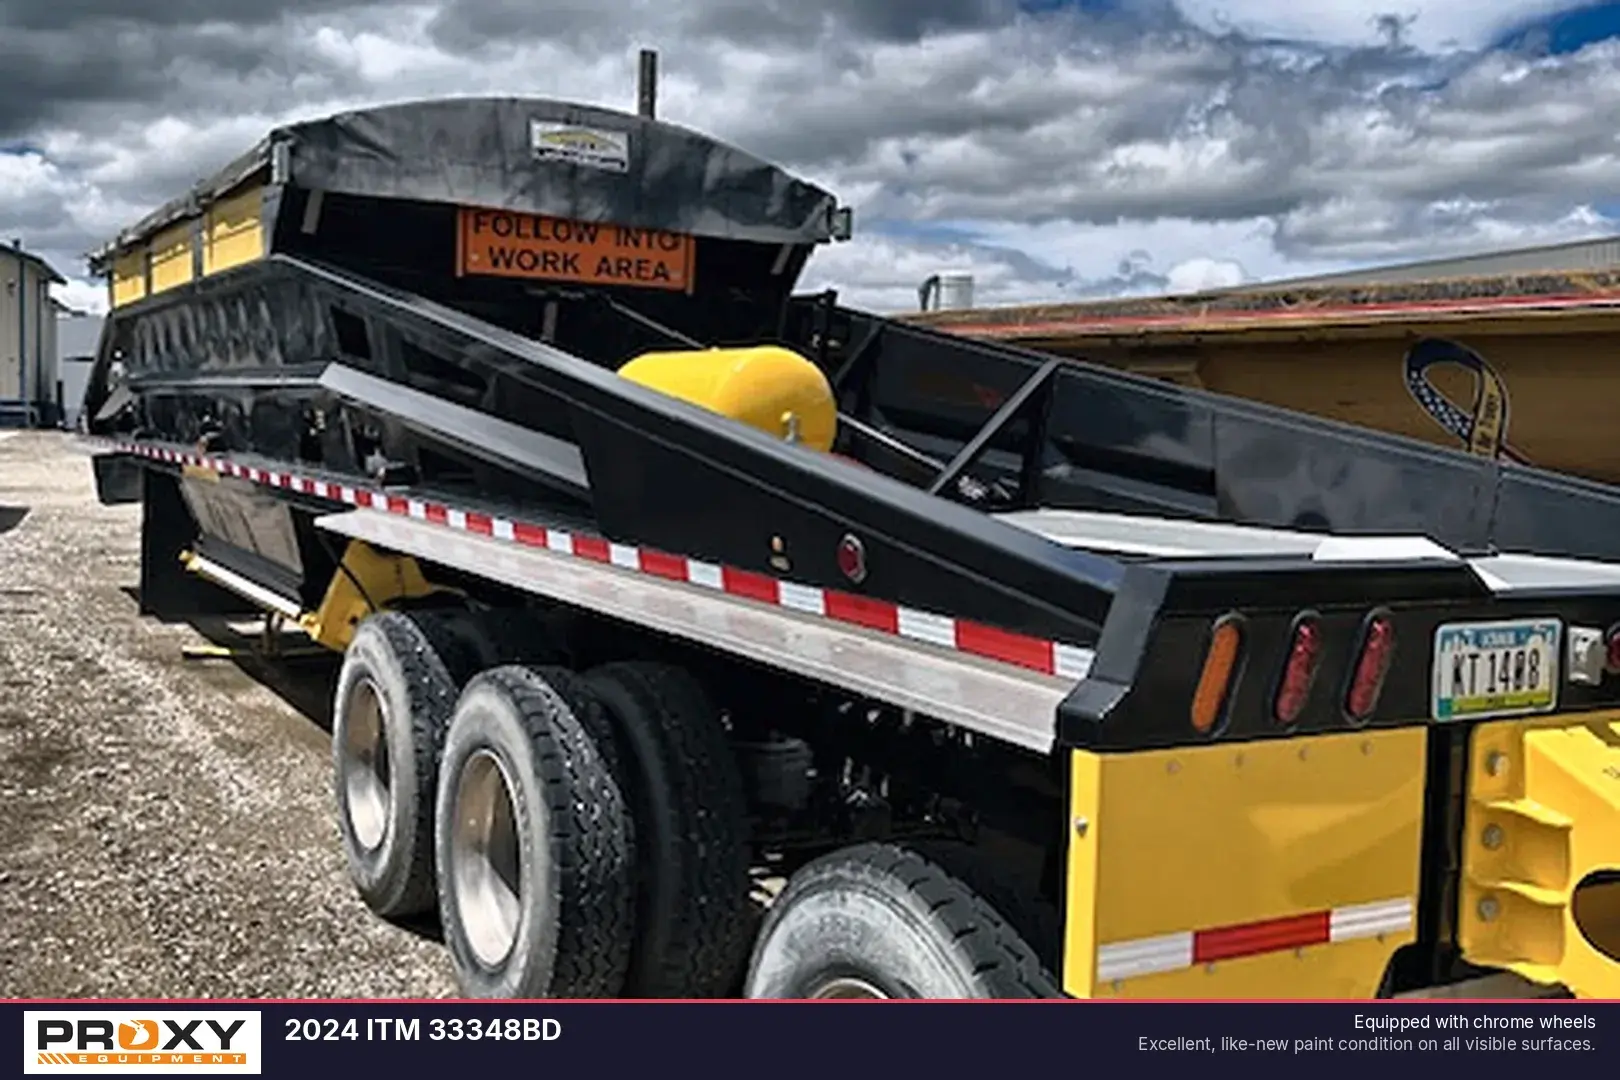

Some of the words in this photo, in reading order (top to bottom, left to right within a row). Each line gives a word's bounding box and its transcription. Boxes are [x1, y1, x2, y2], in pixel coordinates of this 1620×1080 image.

[473, 213, 599, 244] FOLLOW
[616, 227, 682, 251] INTO
[488, 246, 580, 274] WORK
[595, 256, 671, 281] AREA
